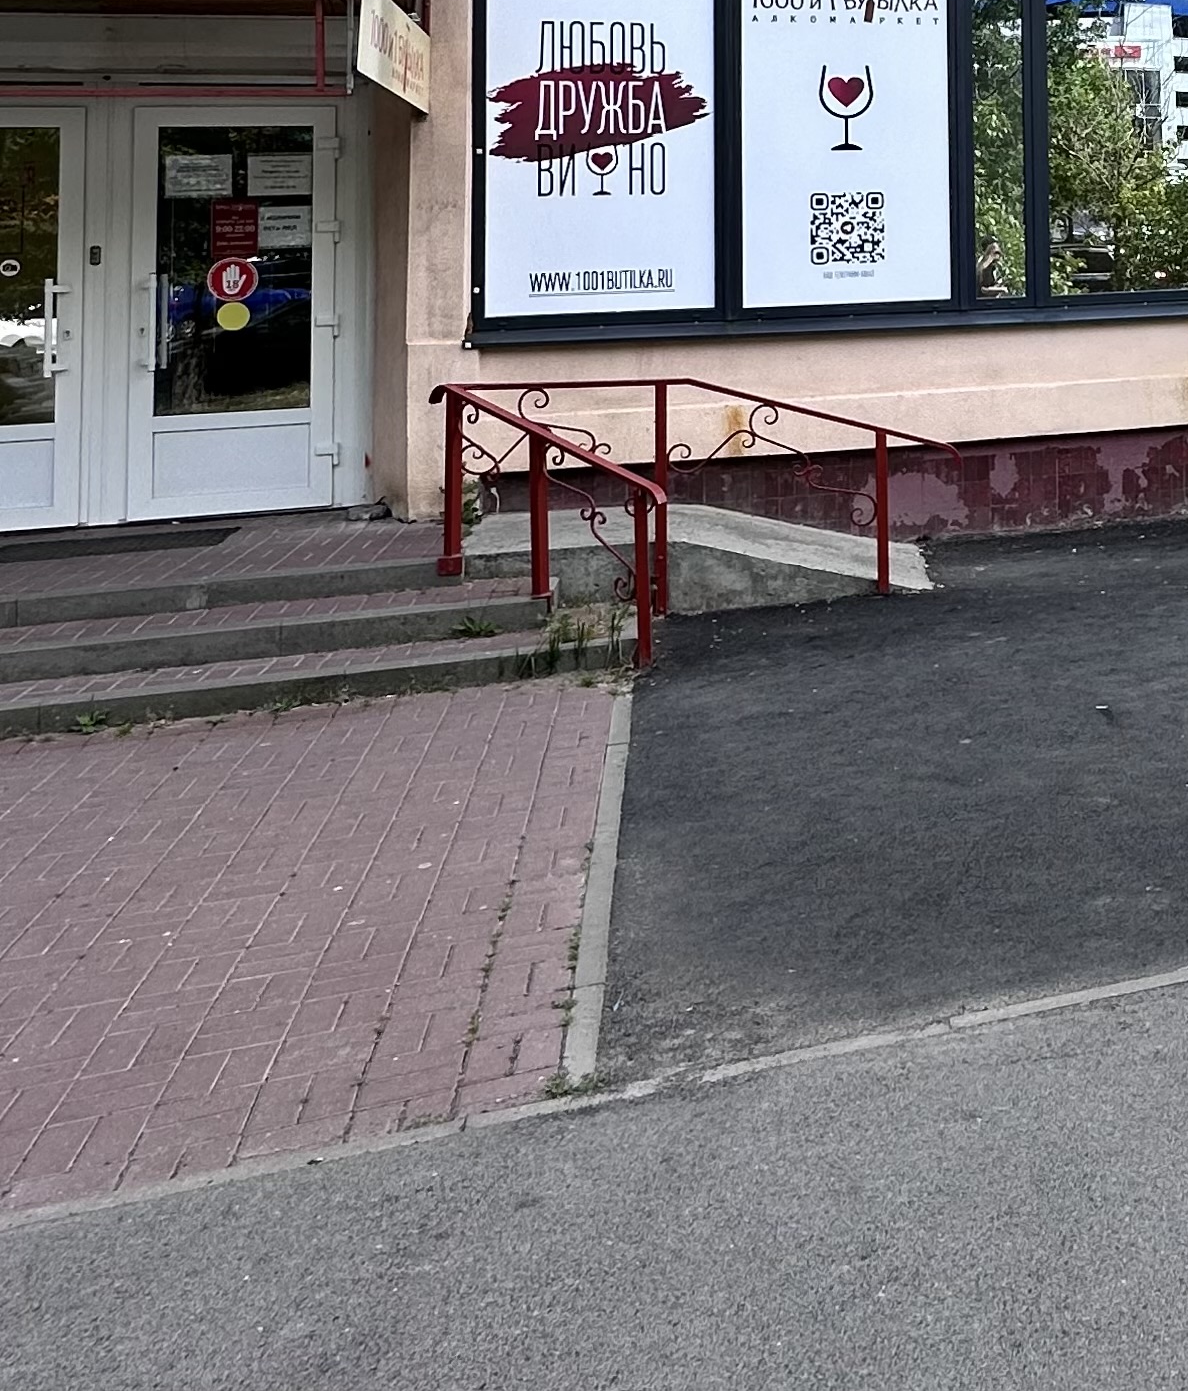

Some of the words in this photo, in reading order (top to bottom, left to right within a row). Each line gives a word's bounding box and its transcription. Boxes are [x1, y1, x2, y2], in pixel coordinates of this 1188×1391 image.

[751, 14, 939, 25] АЛКОМАРКЕТ
[535, 20, 666, 75] ЛЮБОВЬ
[534, 80, 667, 141] ДРУЖБА
[529, 268, 673, 292] WWW.1001BUTILKA.RU
